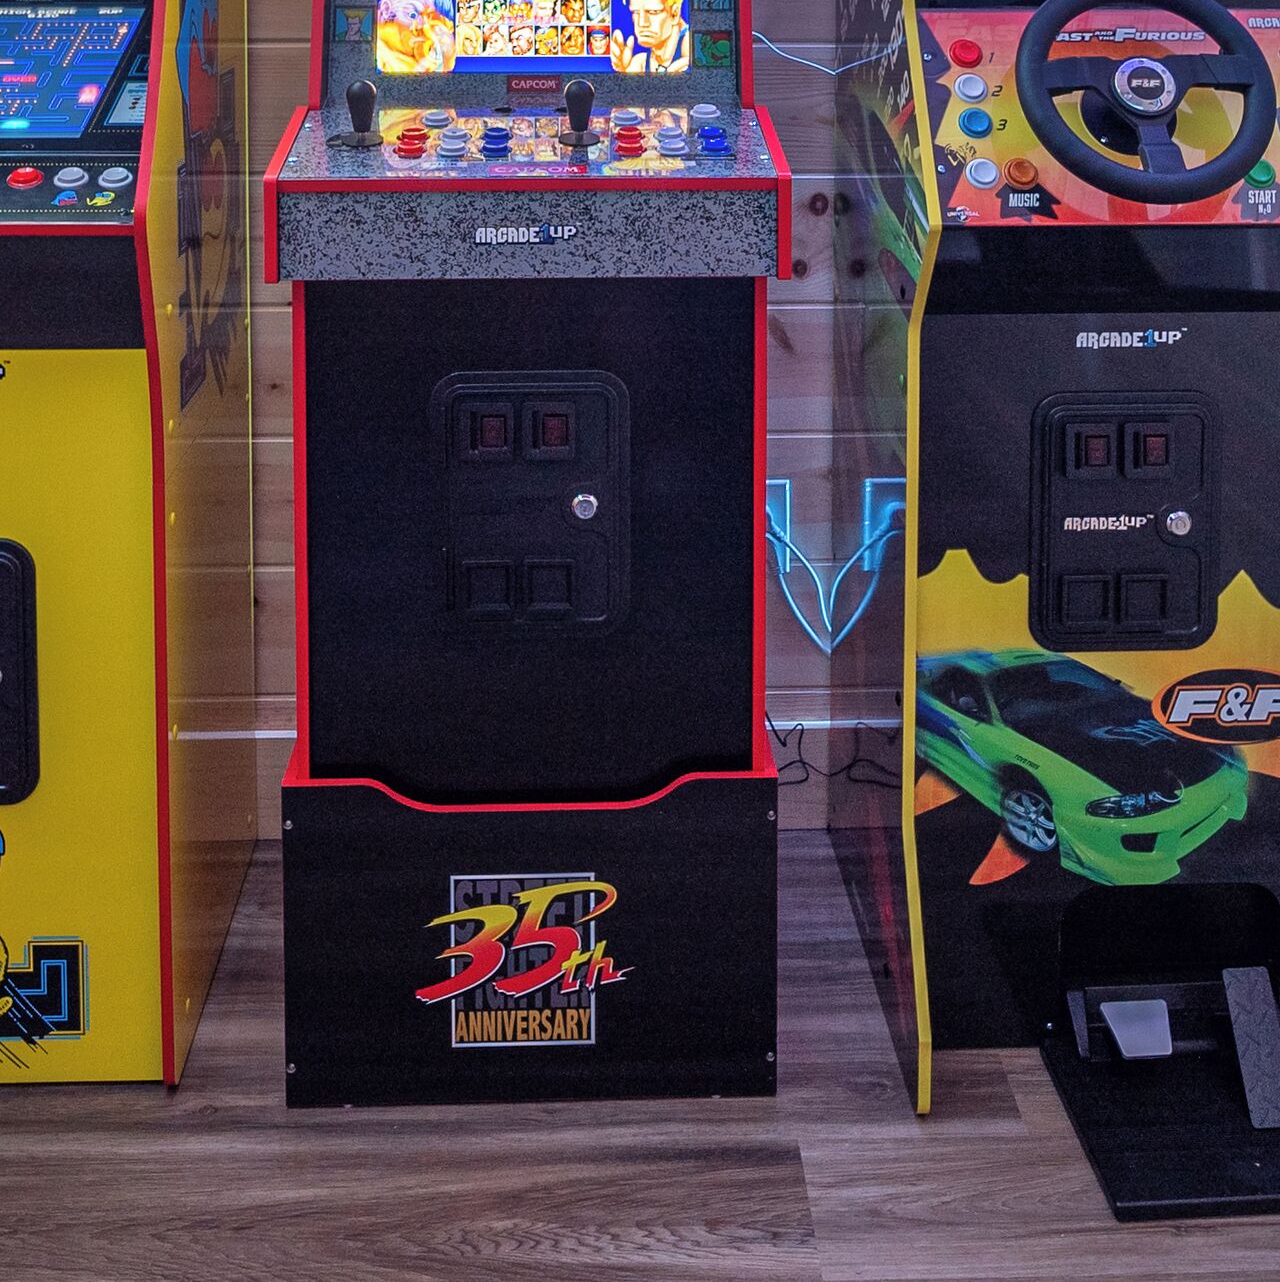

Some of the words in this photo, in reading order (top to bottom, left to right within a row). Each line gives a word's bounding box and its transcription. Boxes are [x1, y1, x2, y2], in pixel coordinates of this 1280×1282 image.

[38, 6, 78, 15] SCORE
[1055, 30, 1093, 42] AST
[1114, 26, 1206, 42] FURIOUS
[988, 52, 996, 64] 1
[2, 75, 38, 83] OVER
[511, 79, 556, 89] CAPCOM
[1131, 78, 1162, 88] F&F
[991, 85, 1004, 98] 2
[996, 118, 1009, 131] 3
[1008, 193, 1040, 207] MUSIC
[1247, 189, 1277, 204] START
[474, 222, 577, 246] ARCADE1UP
[1076, 328, 1182, 349] ARCADE1UP
[1063, 514, 1148, 532] ARCADE1UP
[415, 880, 636, 1006] 35th
[455, 1008, 591, 1043] ANNIVERSARY
